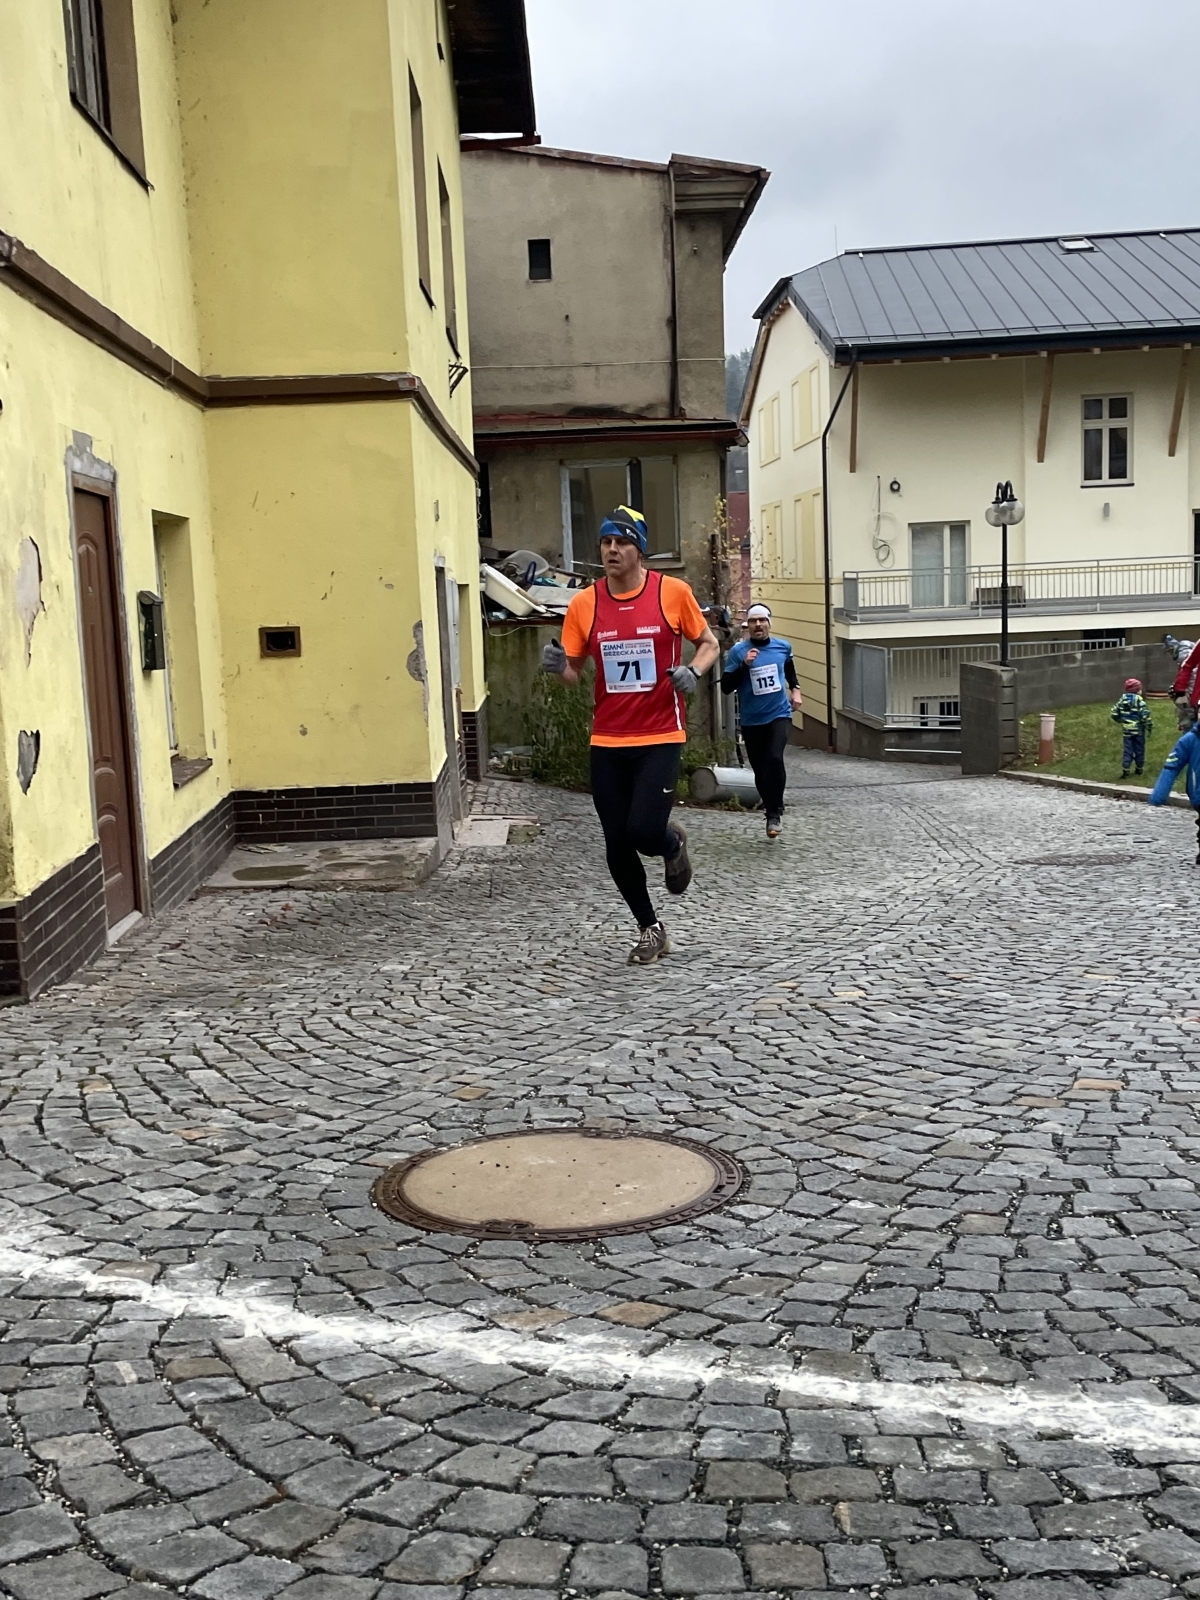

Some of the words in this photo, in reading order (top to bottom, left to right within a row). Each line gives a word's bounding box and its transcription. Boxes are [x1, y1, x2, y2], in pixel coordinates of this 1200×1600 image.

[602, 643, 624, 651] ZIMNÍ
[616, 660, 641, 681] 71
[756, 675, 776, 689] 113
